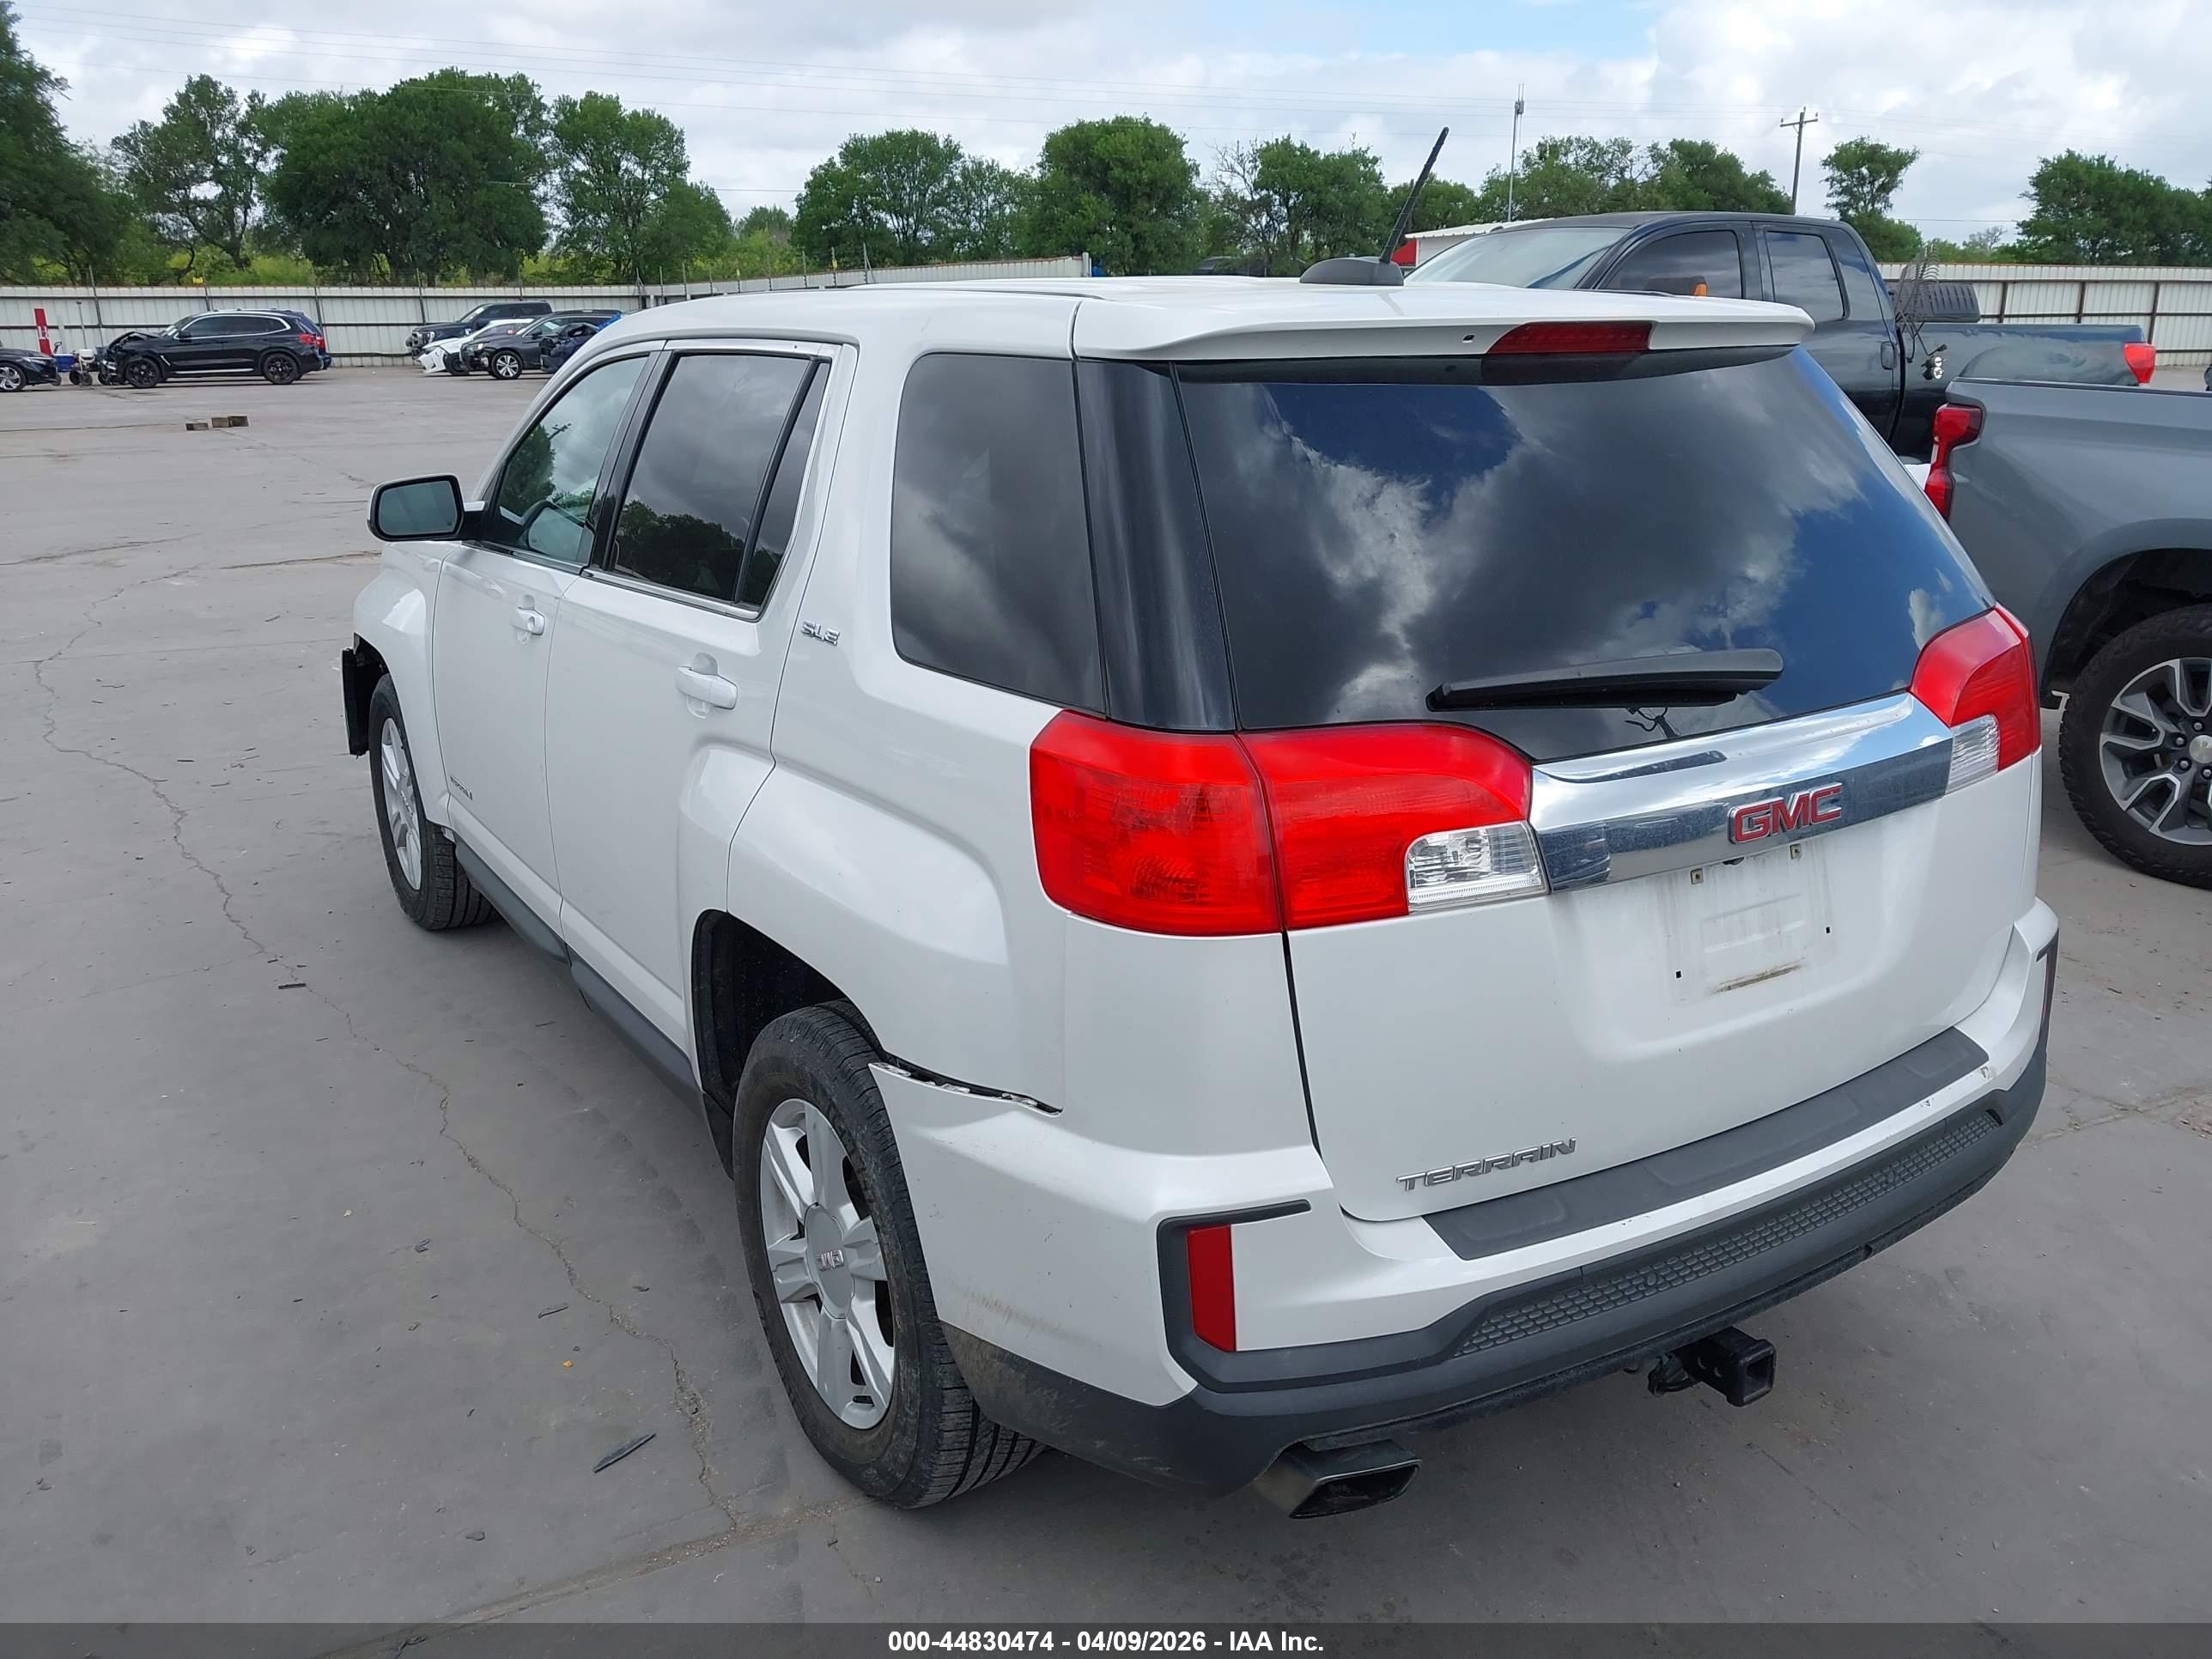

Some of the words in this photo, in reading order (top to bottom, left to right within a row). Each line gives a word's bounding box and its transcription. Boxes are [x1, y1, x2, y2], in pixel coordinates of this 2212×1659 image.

[801, 619, 841, 647] SLE
[1728, 781, 1843, 844] GMC
[1395, 1136, 1577, 1192] TERRAIN
